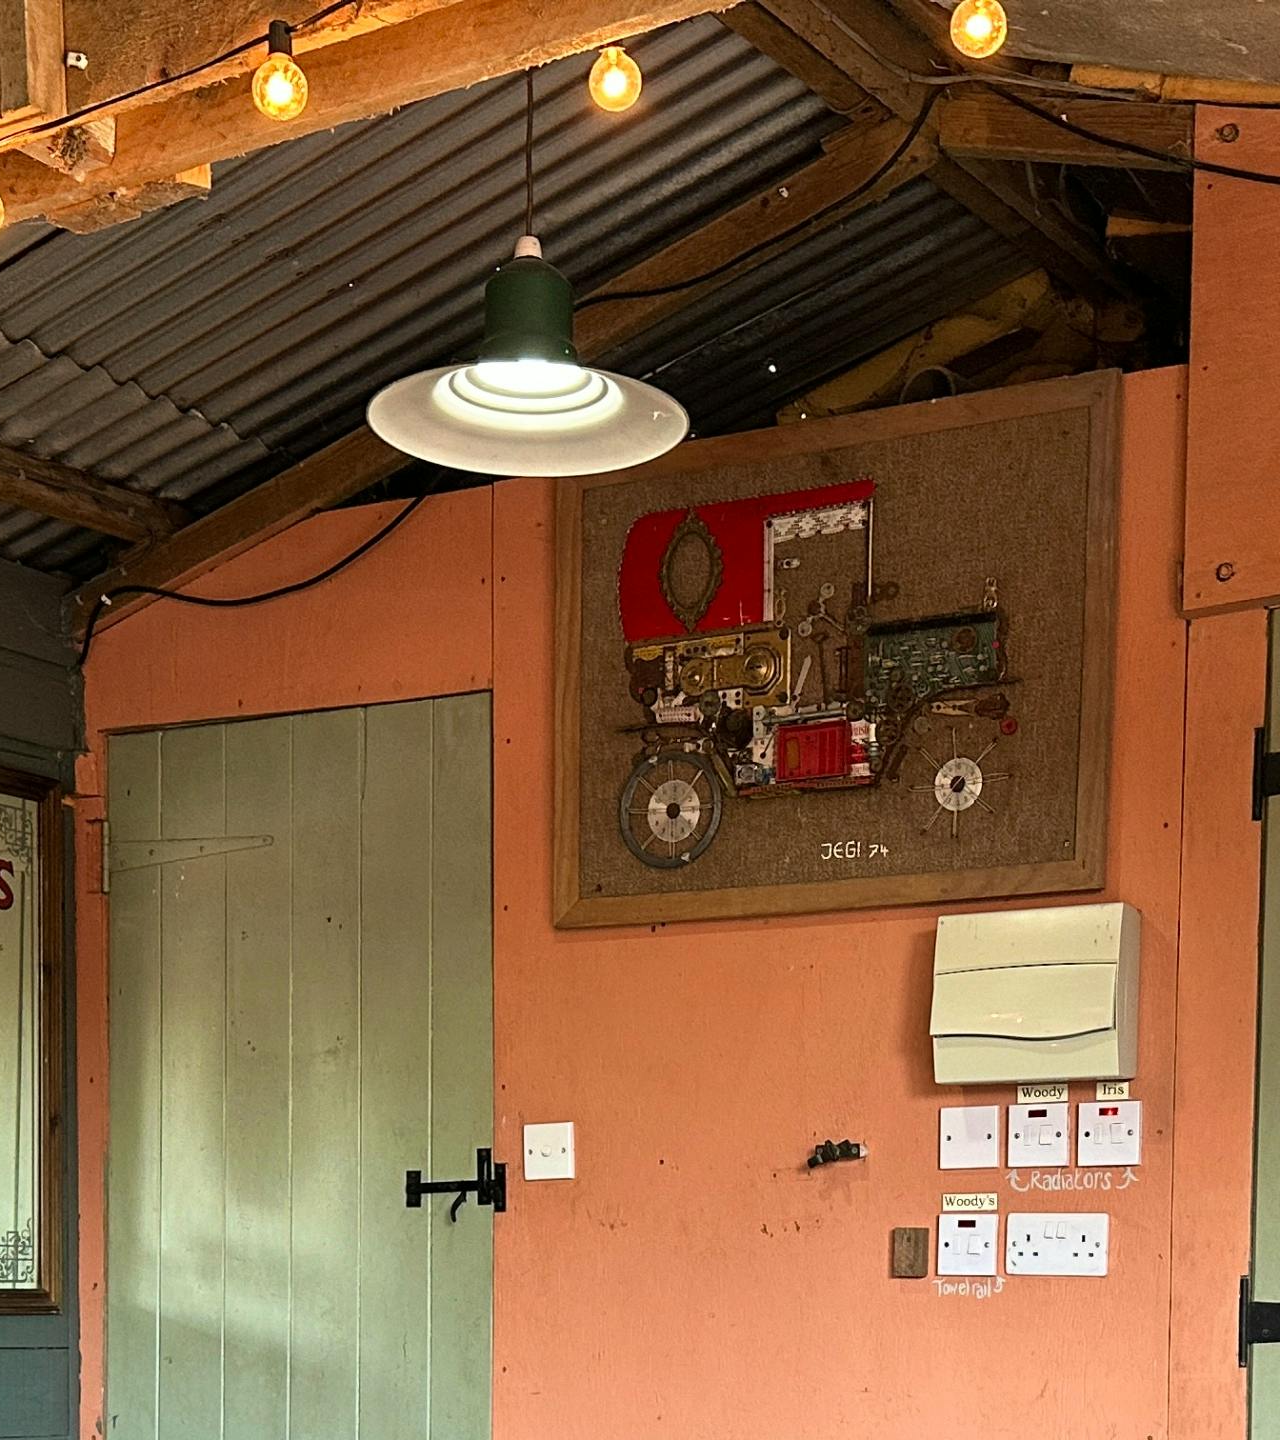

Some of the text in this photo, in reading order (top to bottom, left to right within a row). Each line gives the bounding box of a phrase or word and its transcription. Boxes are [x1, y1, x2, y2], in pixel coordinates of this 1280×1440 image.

[820, 841, 889, 860] JEGI 74
[1021, 1086, 1065, 1101] Woody
[1102, 1084, 1125, 1096] Iris
[1030, 1169, 1113, 1191] Radiators
[944, 1195, 996, 1209] Woody's
